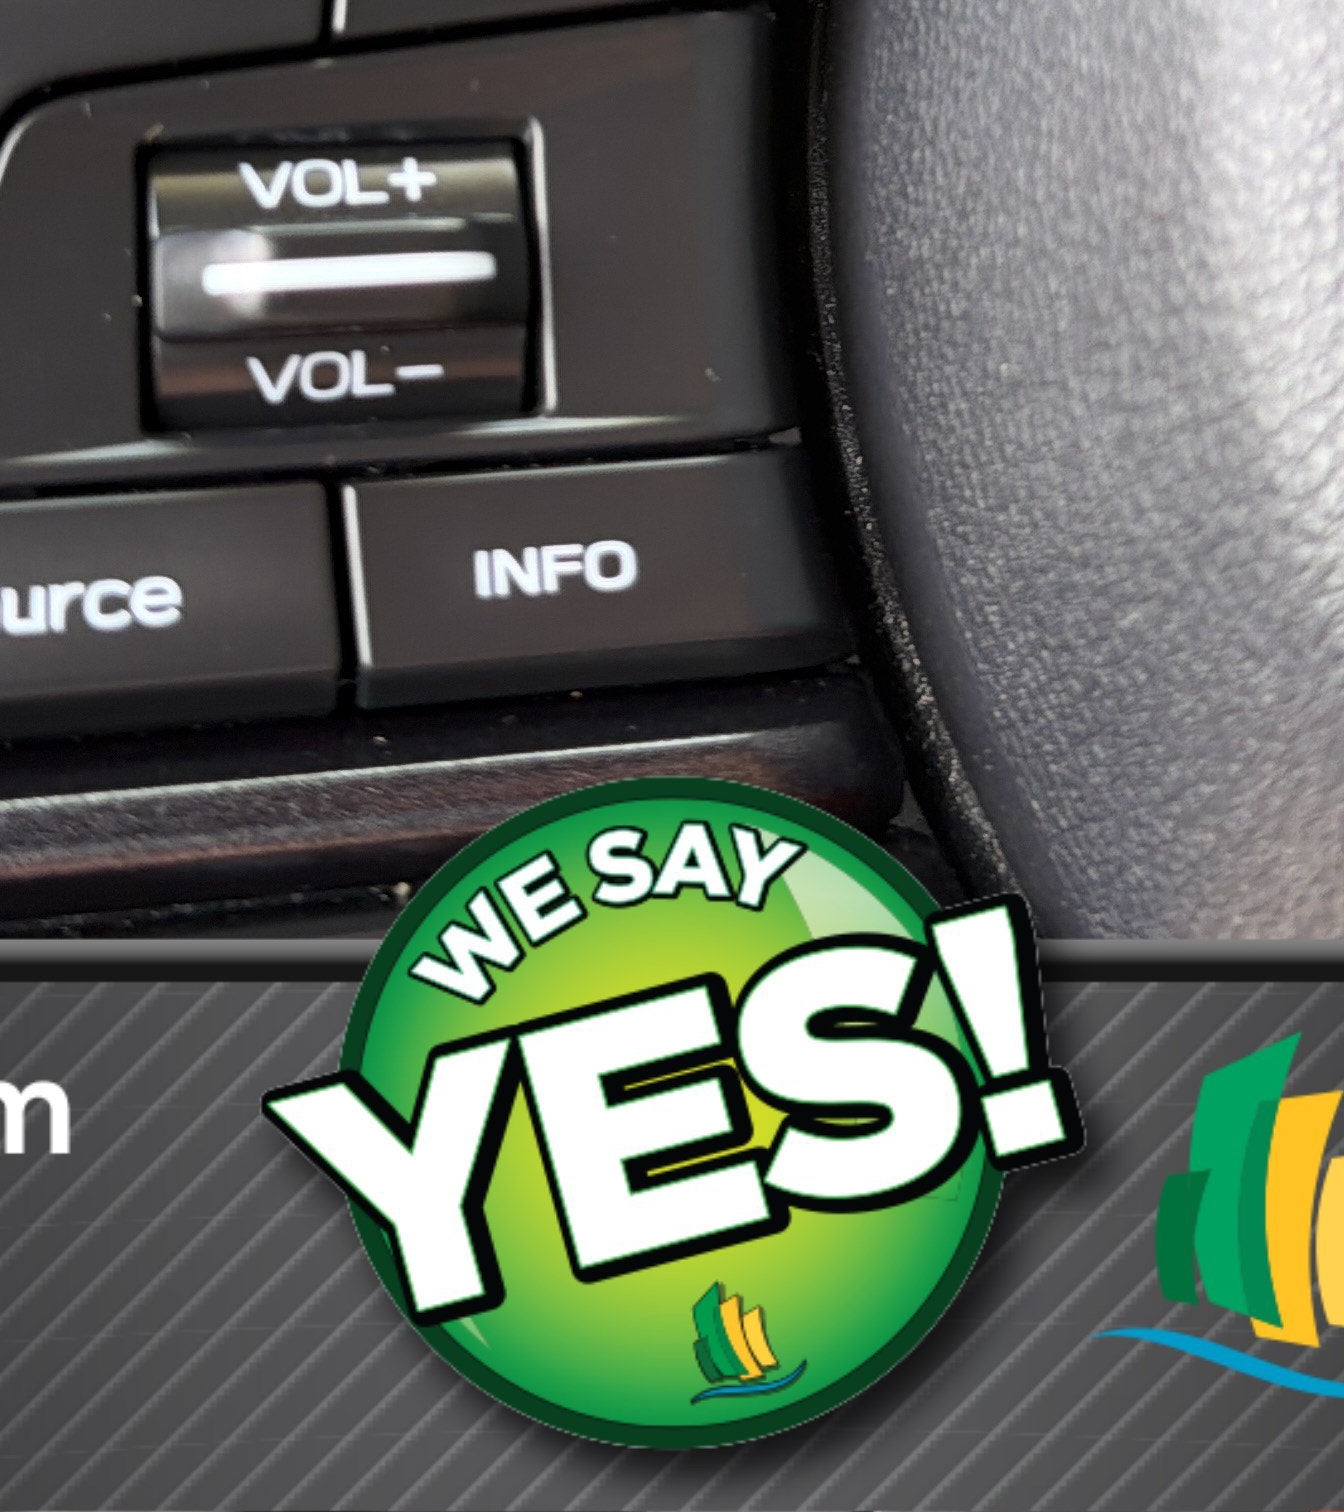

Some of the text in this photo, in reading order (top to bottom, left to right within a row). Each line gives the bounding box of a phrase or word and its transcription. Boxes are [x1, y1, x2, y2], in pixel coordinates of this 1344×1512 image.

[238, 155, 438, 210] VOL+
[246, 349, 446, 406] VOL-
[473, 538, 639, 601] INFO
